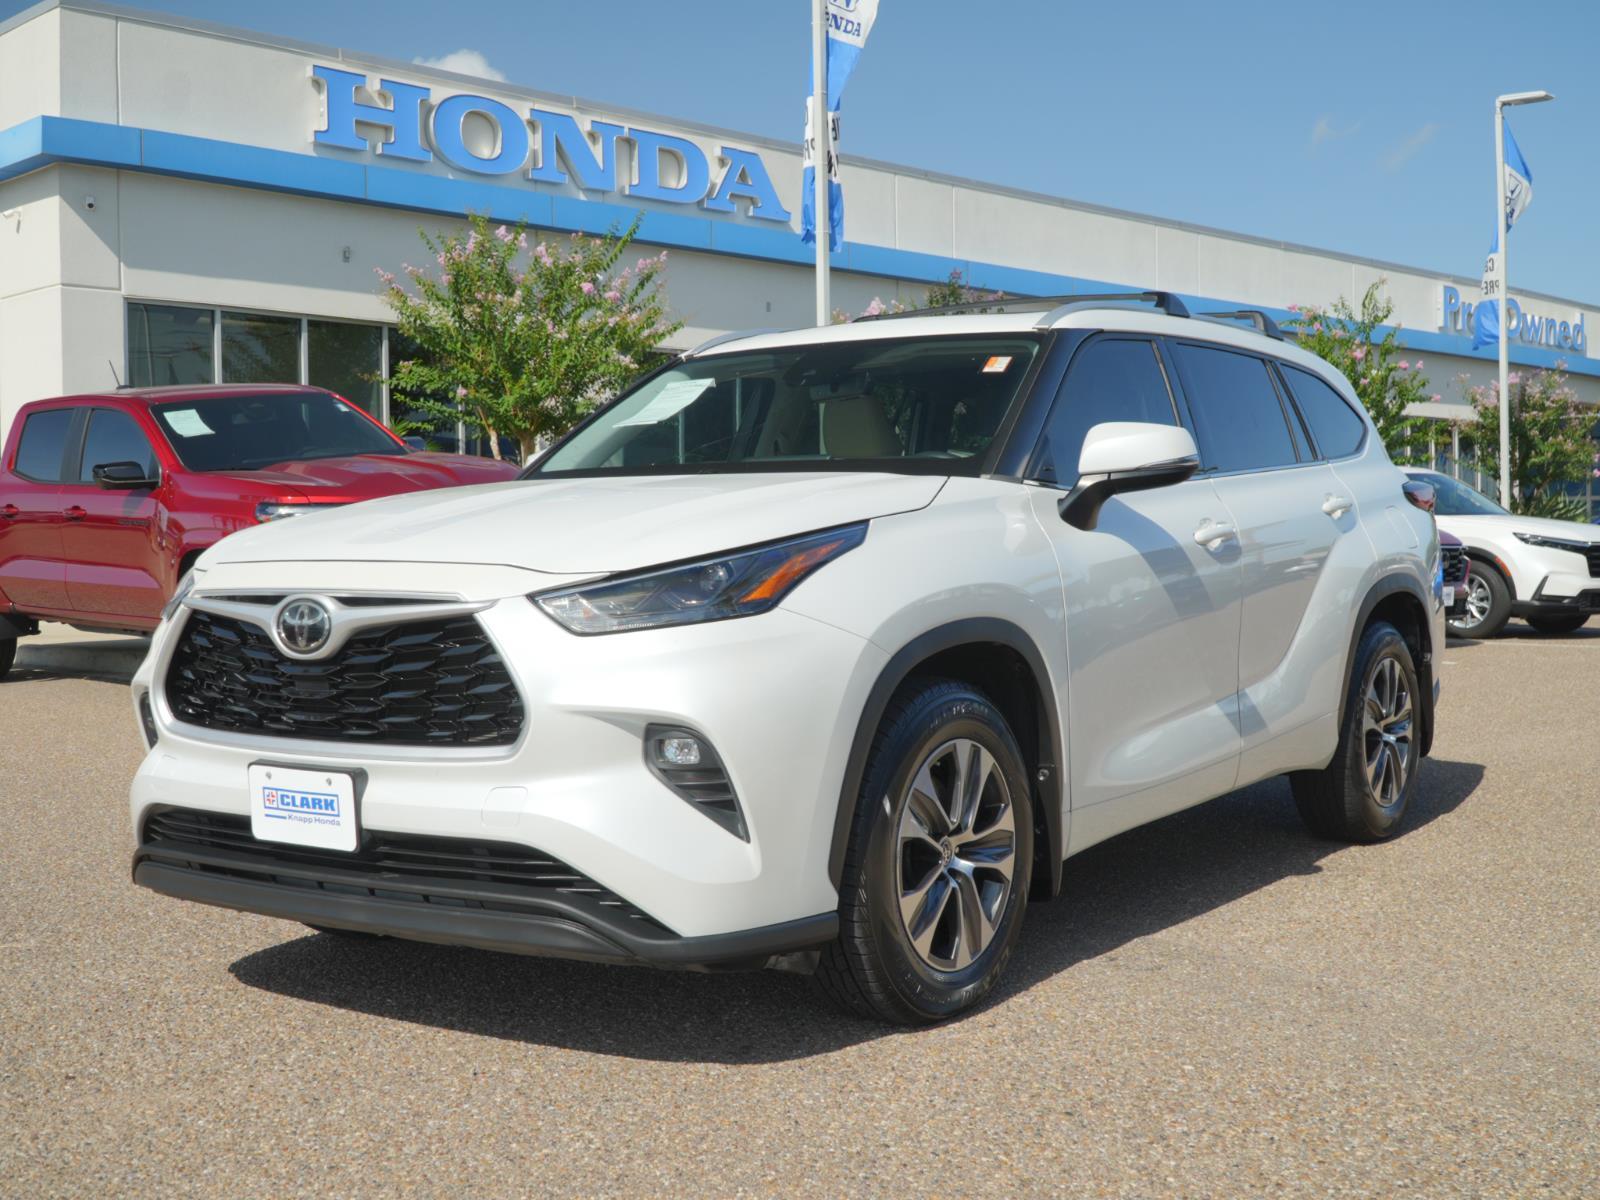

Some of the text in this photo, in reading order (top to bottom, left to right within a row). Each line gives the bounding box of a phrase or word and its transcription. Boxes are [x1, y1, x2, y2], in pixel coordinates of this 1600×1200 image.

[826, 12, 862, 37] NDA
[308, 64, 791, 222] HONDA
[279, 793, 336, 812] CLARK
[287, 813, 341, 827] Knapp Honda
